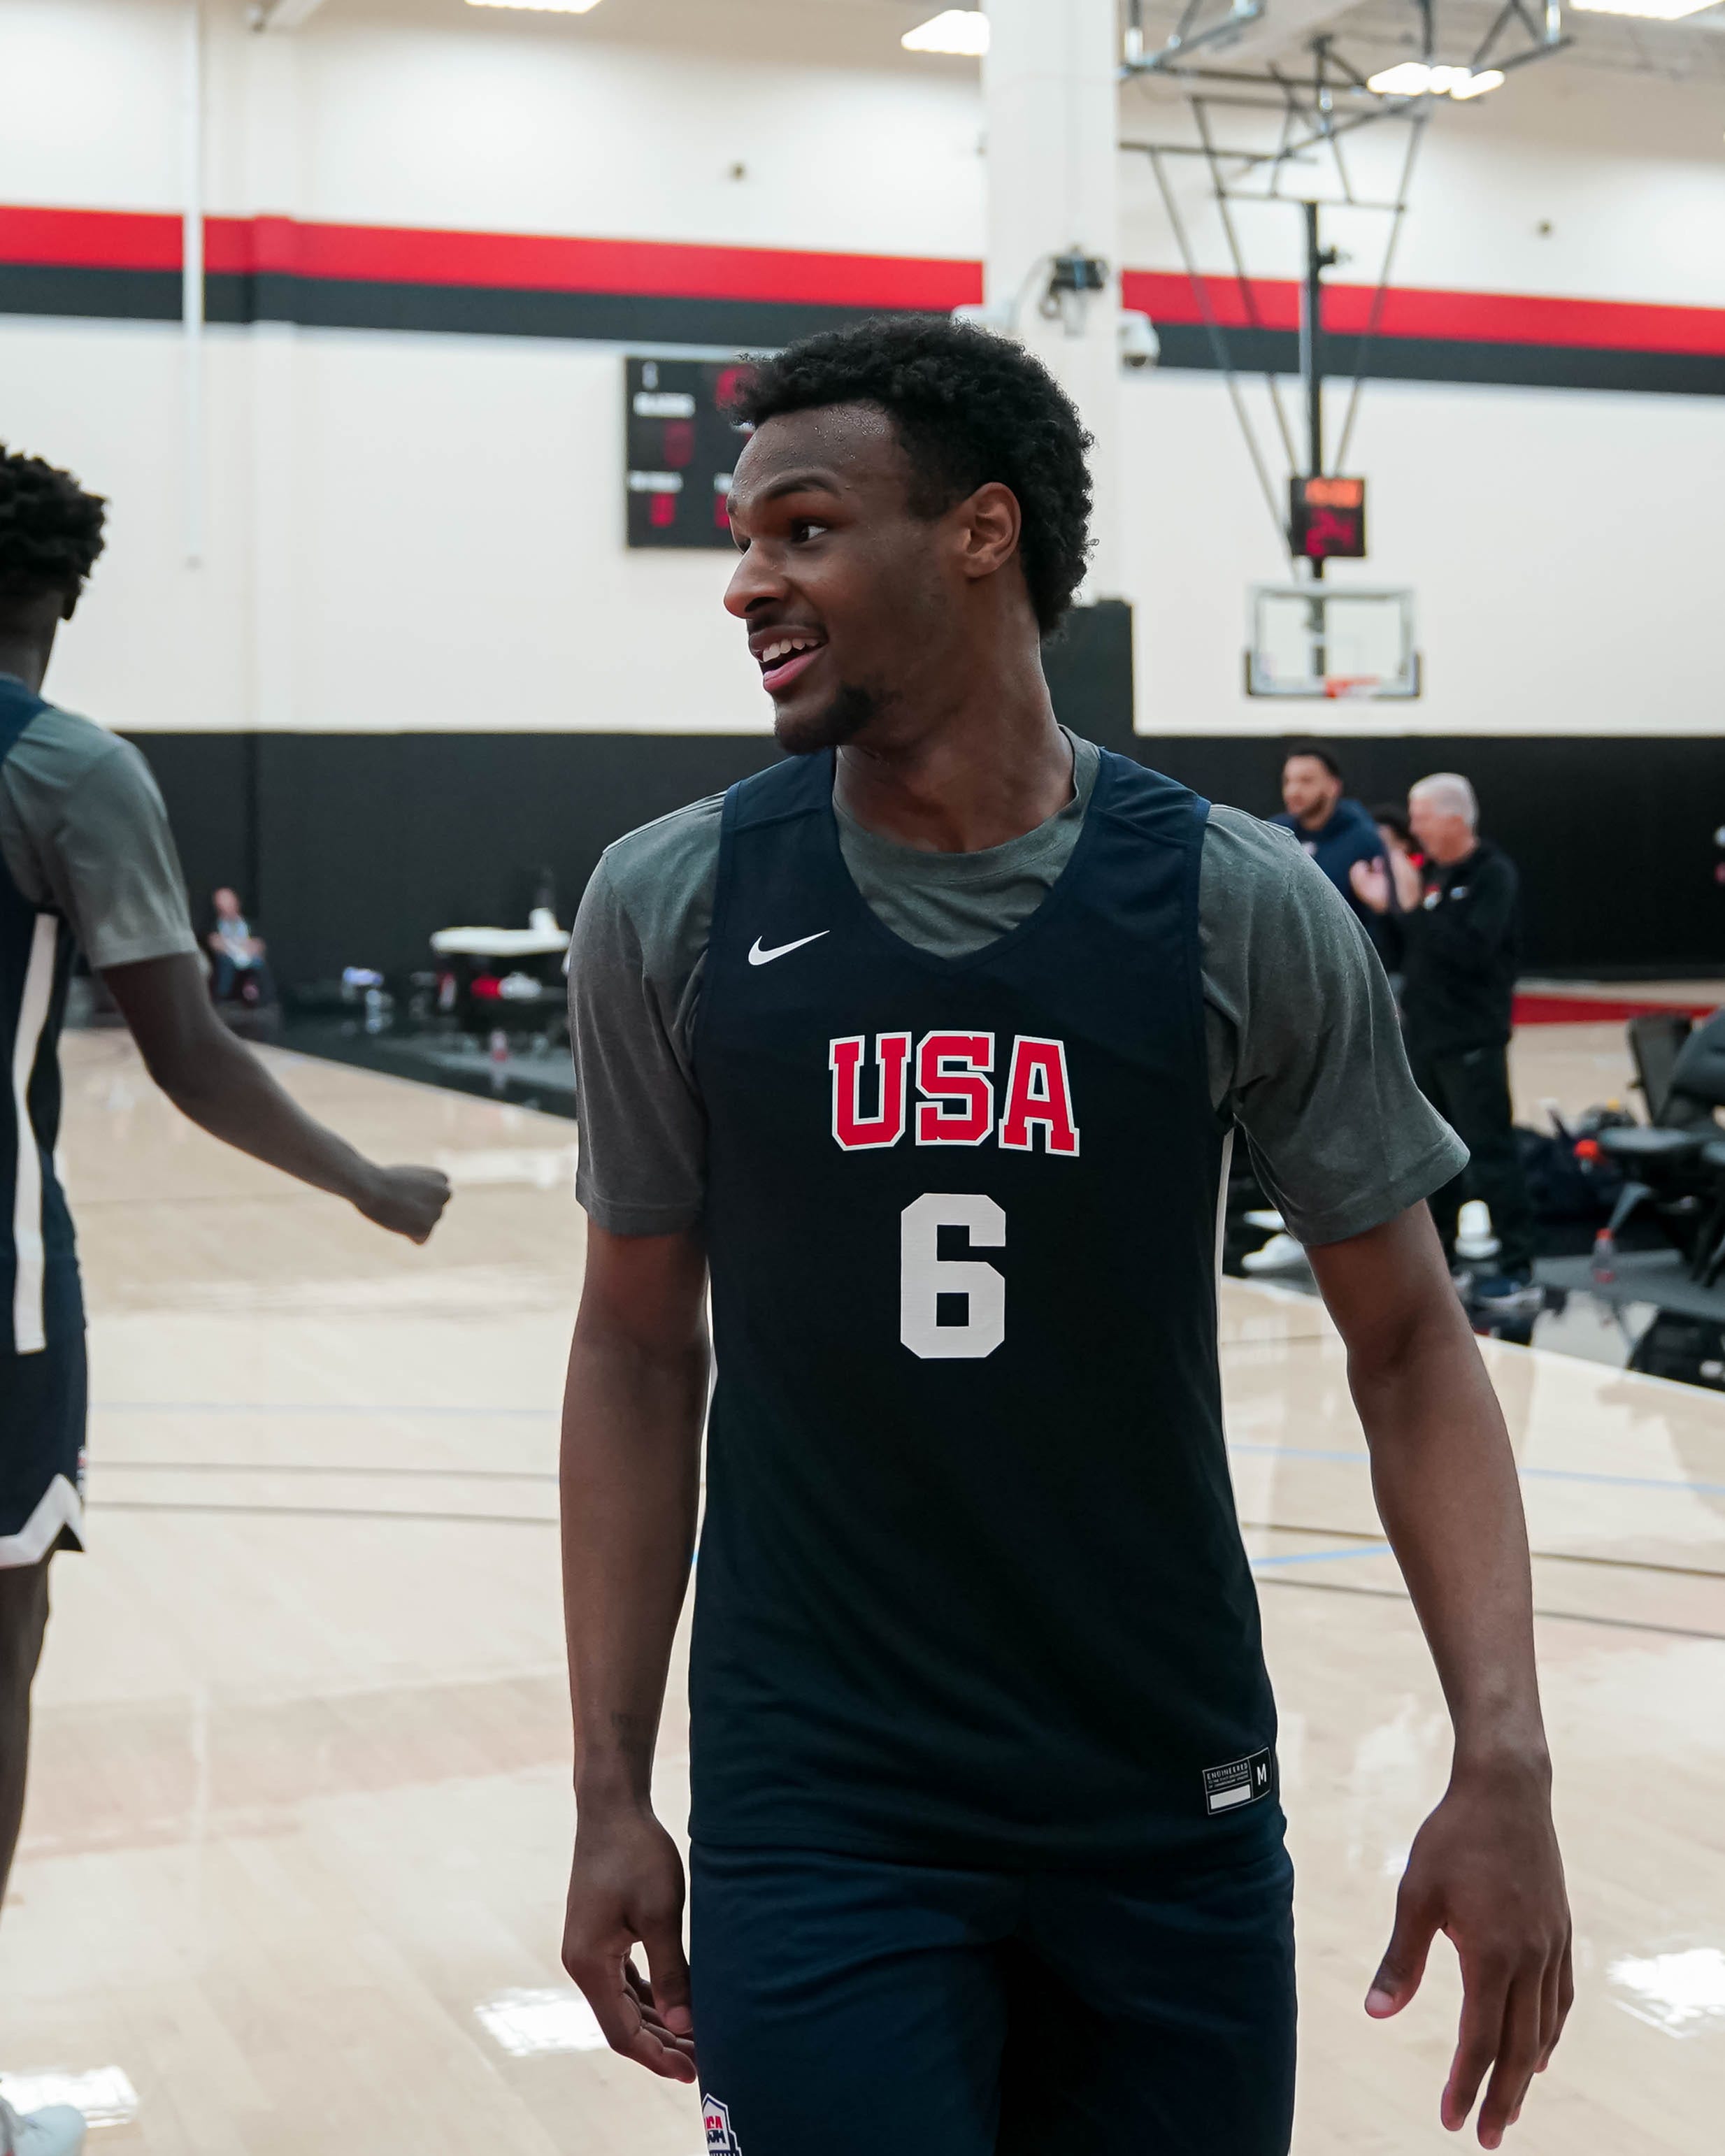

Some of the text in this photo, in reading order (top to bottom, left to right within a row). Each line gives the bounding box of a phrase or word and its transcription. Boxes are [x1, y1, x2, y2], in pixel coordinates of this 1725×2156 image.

[829, 1030, 1080, 1157] USA
[901, 1193, 1006, 1358] 6
[1257, 1763, 1267, 1785] M
